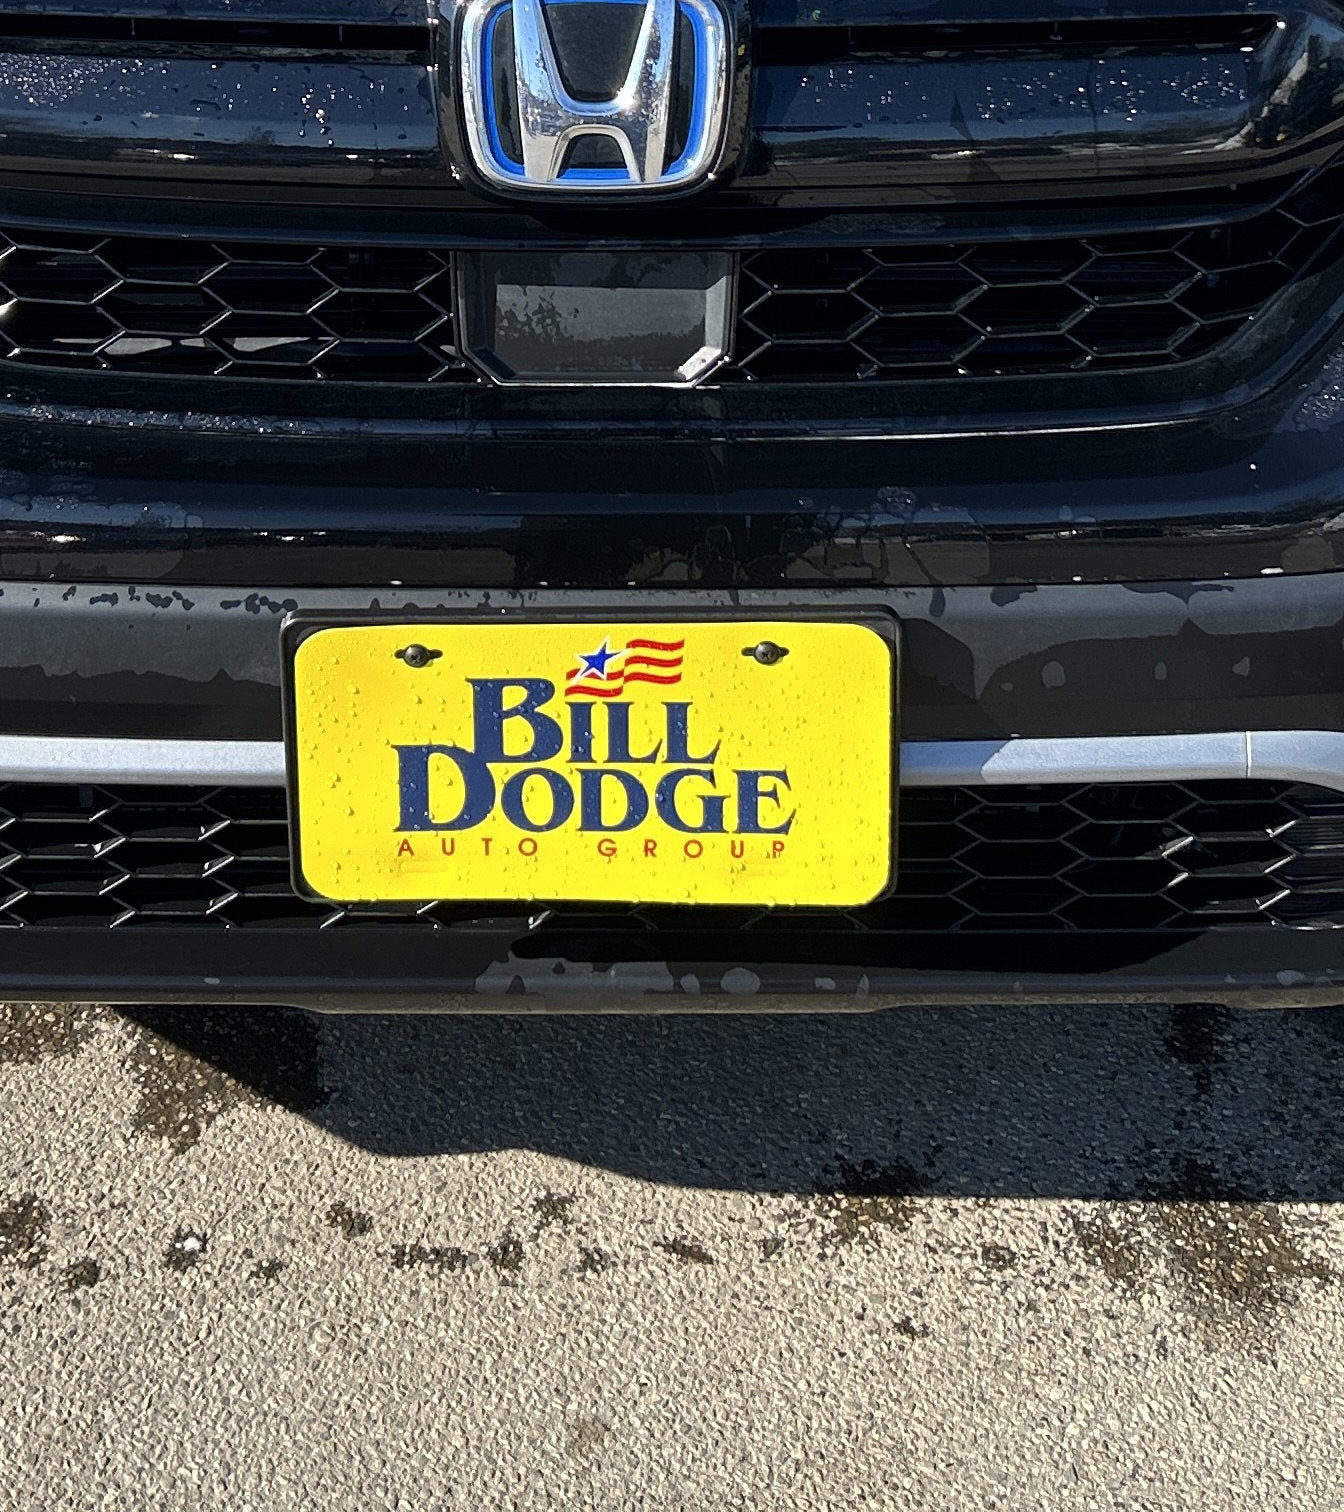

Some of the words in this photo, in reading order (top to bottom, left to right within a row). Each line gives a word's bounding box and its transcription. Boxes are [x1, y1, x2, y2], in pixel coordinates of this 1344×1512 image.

[465, 677, 721, 764] BILL
[391, 743, 797, 836] DODGE
[397, 838, 539, 858] AUTO
[597, 838, 787, 859] GROUP
